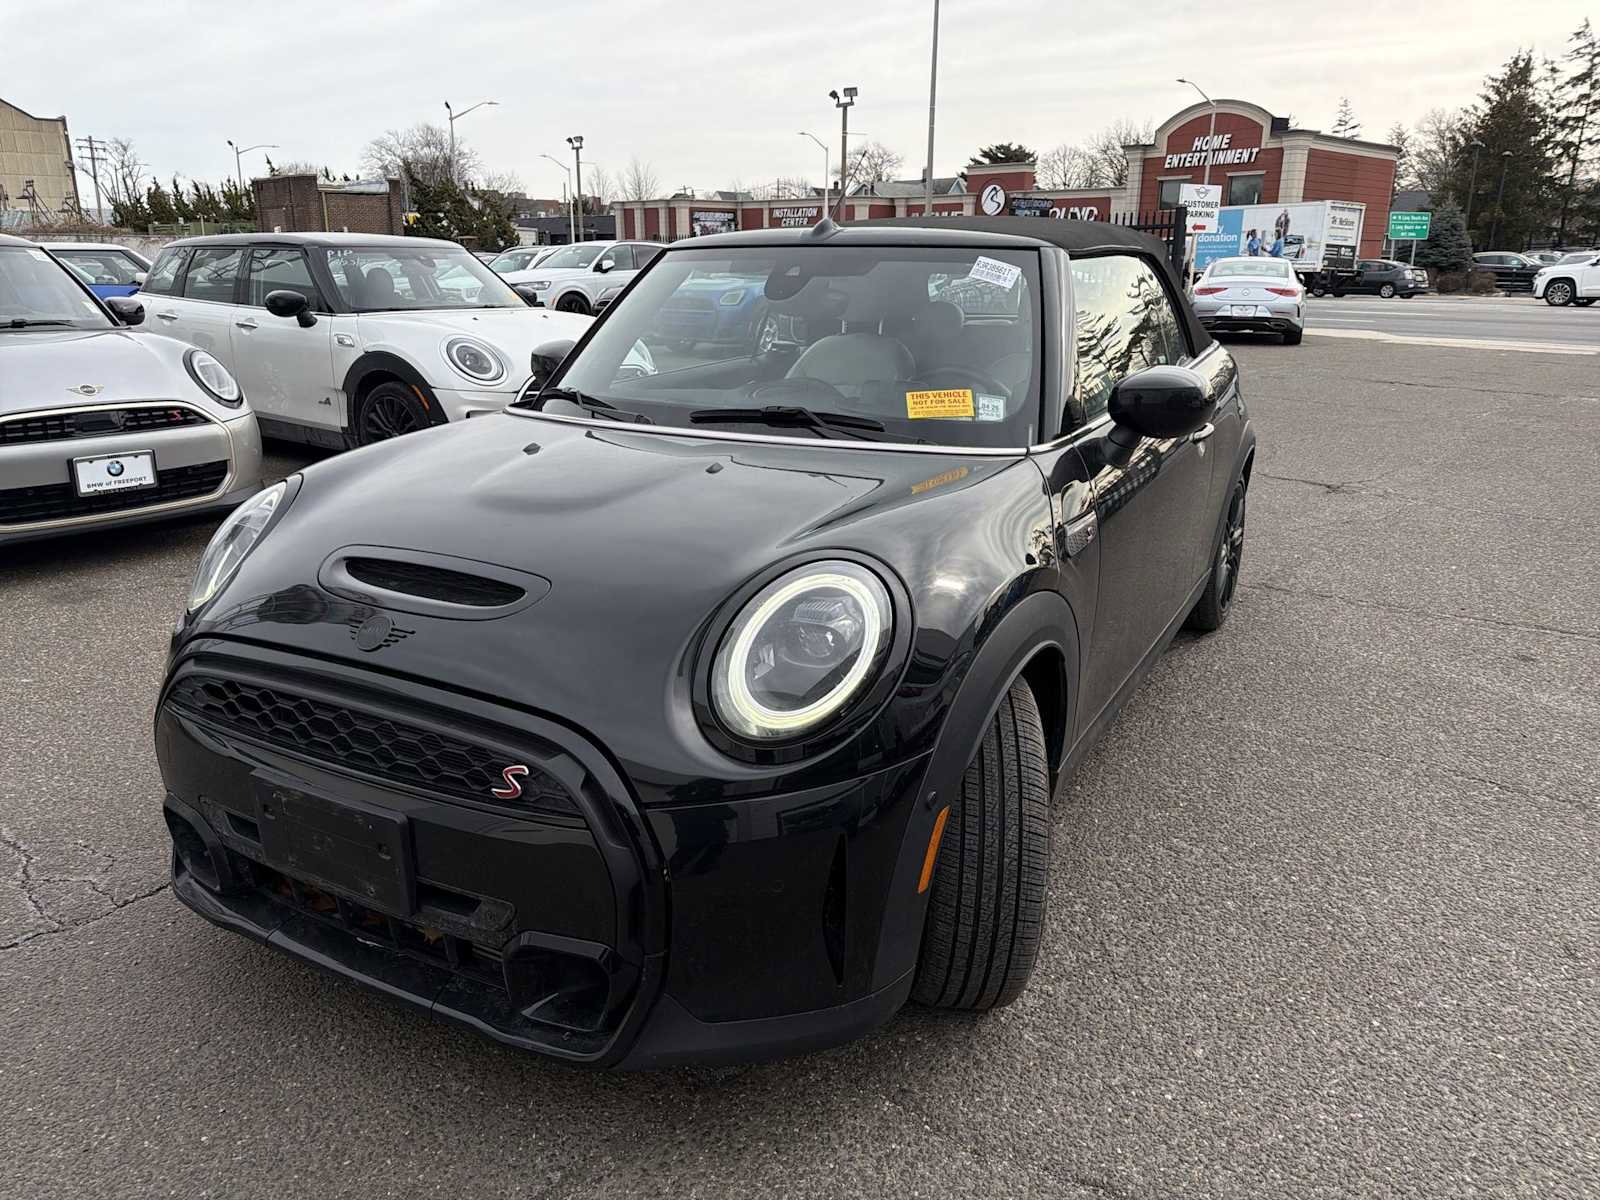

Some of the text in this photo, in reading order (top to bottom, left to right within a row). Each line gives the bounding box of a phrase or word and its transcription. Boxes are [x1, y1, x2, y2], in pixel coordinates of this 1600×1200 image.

[1192, 134, 1232, 151] HOME
[1164, 148, 1259, 169] ENTERTAINMENT
[1183, 200, 1219, 209] CUSTOMER
[773, 207, 818, 218] INSTALLATION
[1049, 207, 1099, 221] OUND
[1186, 210, 1215, 219] PARKING
[781, 217, 808, 226] CENTER
[1198, 234, 1238, 242] donation
[932, 391, 969, 399] VEHICLE
[86, 481, 105, 489] BMW
[113, 476, 147, 485] FREEPORT
[491, 765, 529, 799] S
